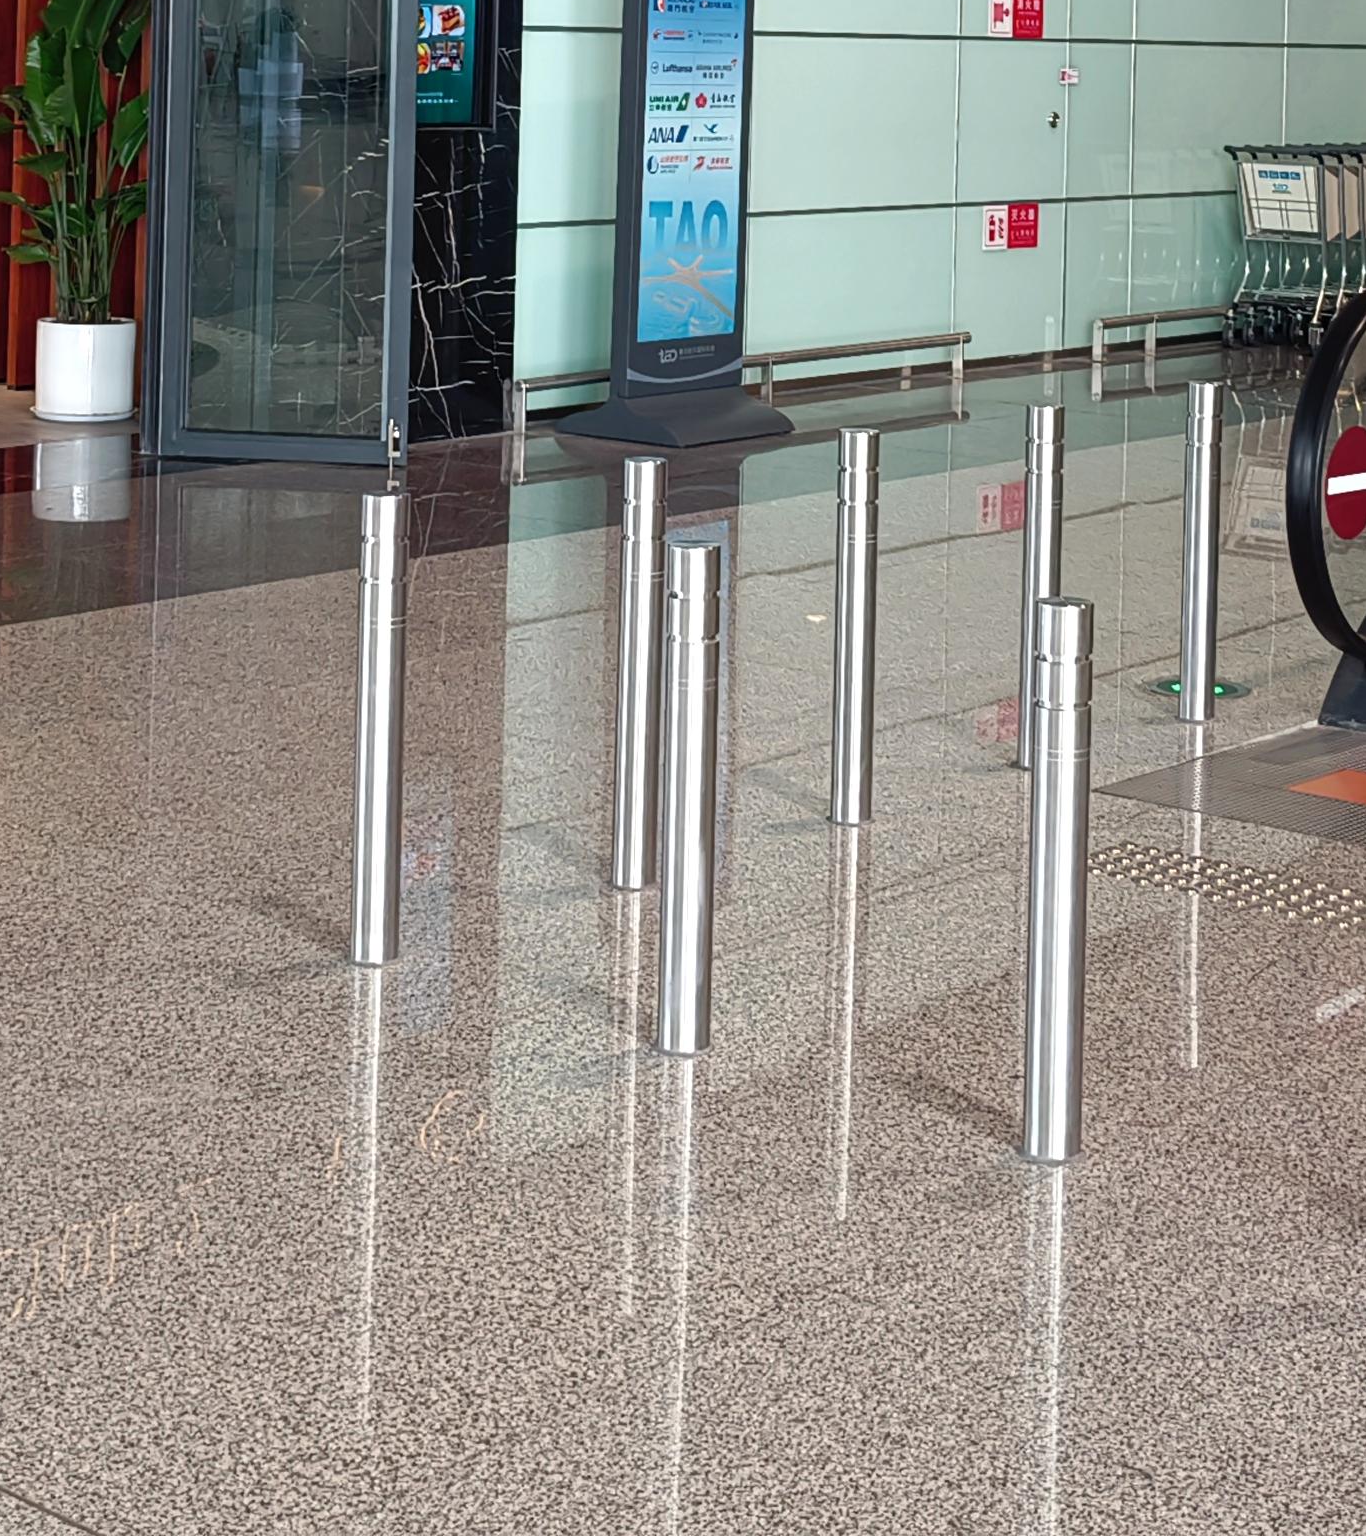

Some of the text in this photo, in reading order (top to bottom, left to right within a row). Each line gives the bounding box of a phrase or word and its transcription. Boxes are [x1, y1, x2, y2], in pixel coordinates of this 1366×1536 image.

[663, 64, 693, 73] Lufthansa
[648, 127, 675, 144] ANA
[649, 199, 729, 249] TAO
